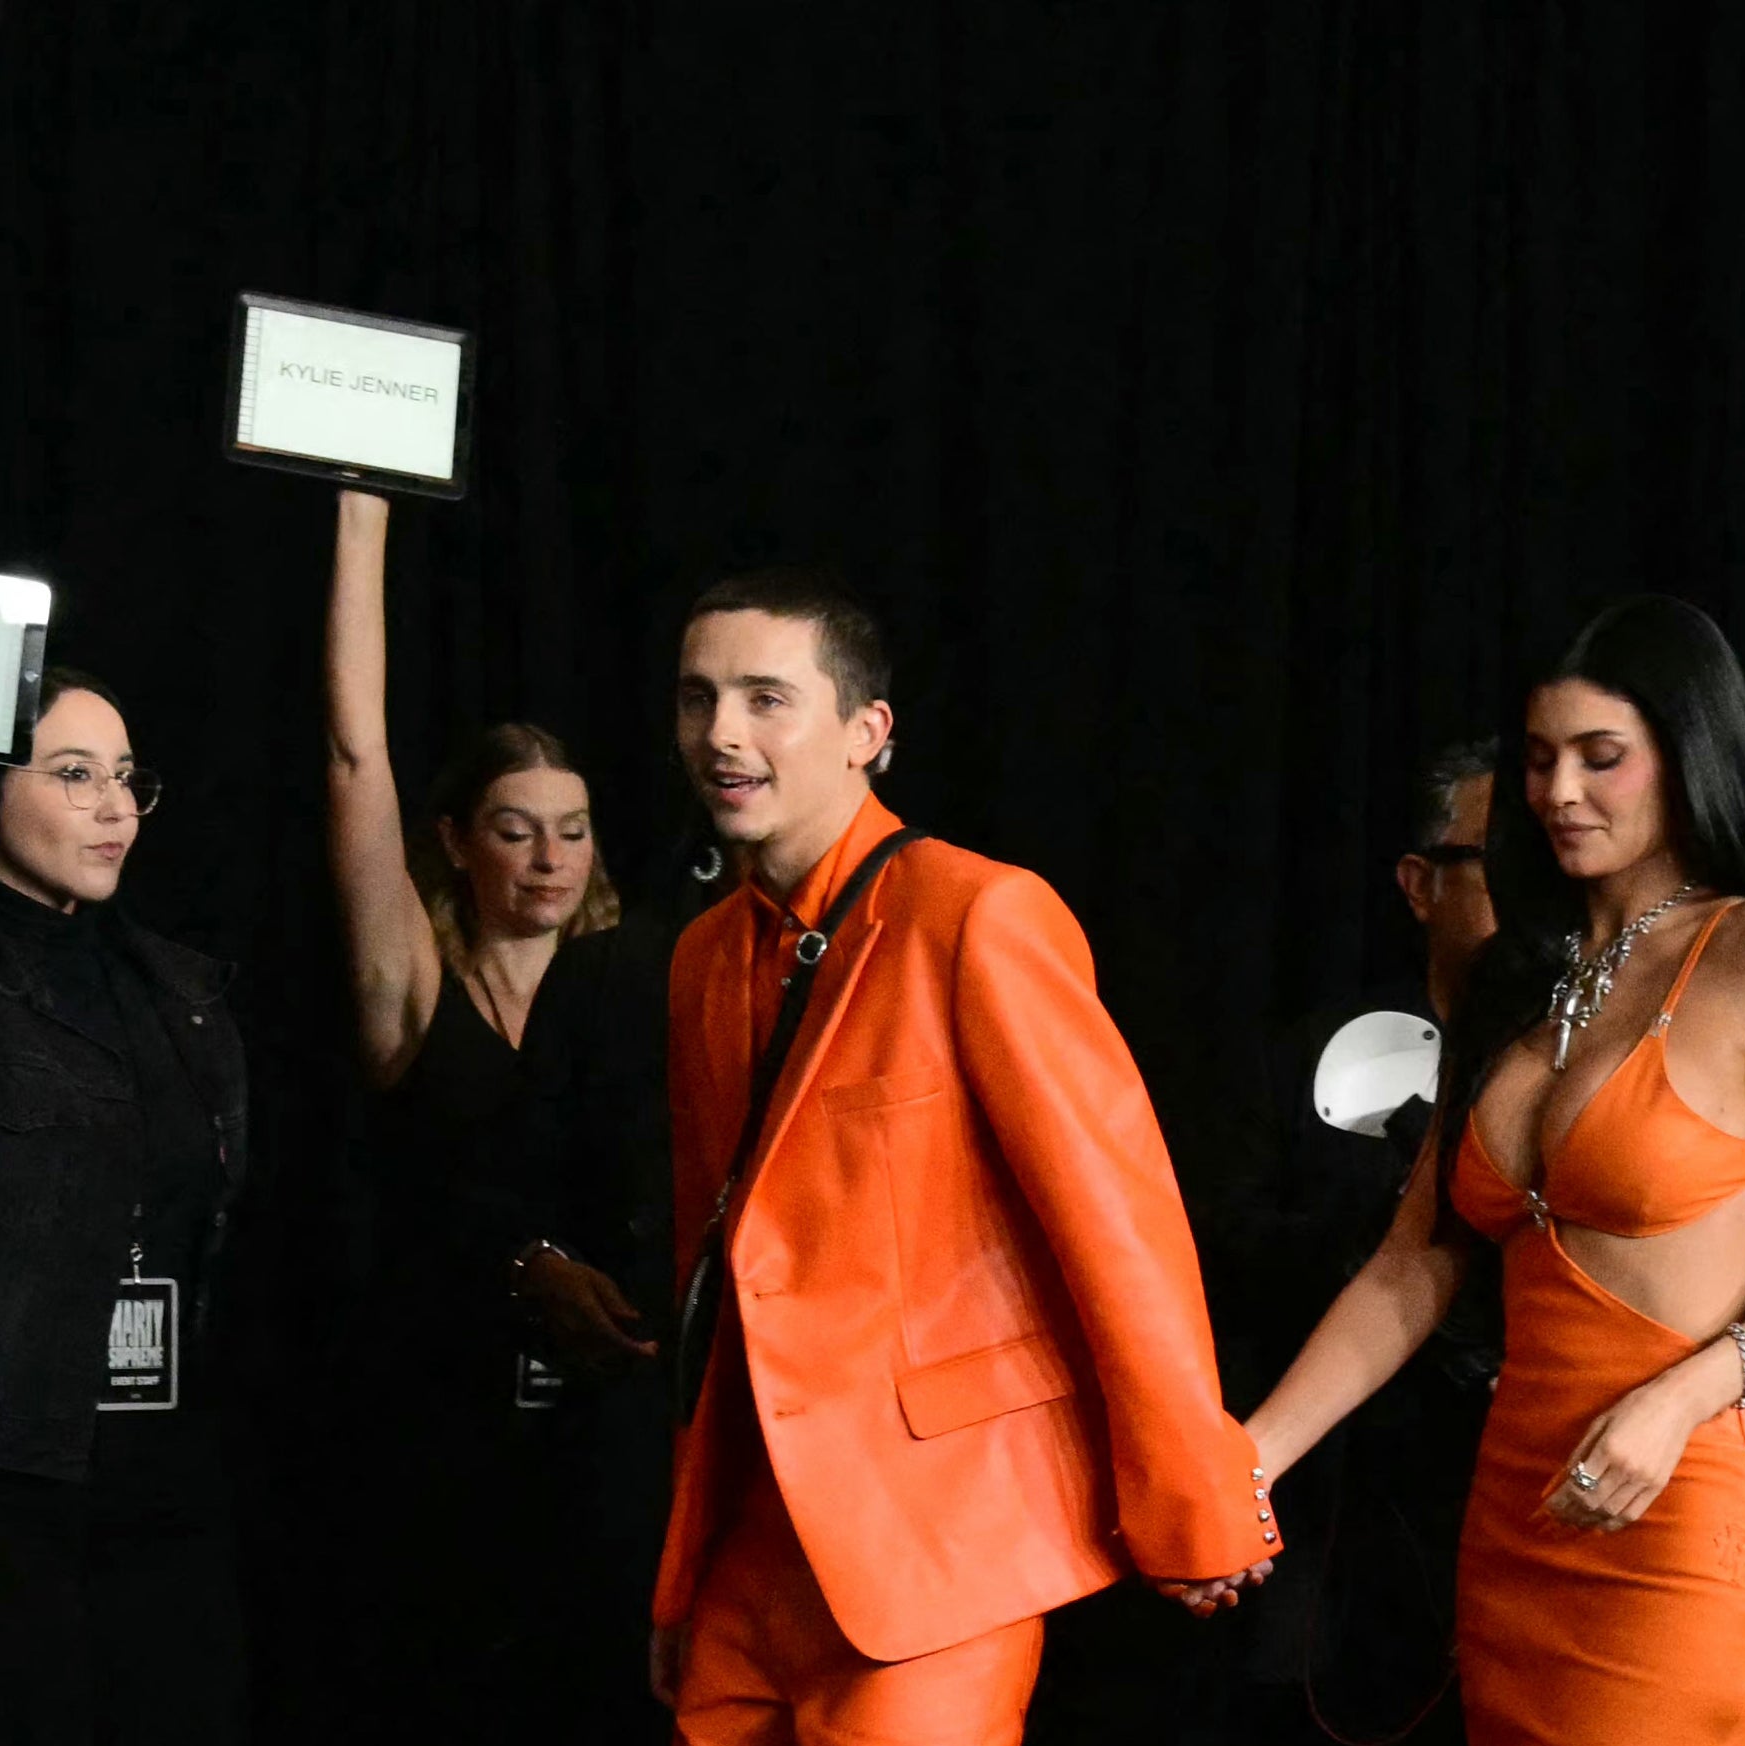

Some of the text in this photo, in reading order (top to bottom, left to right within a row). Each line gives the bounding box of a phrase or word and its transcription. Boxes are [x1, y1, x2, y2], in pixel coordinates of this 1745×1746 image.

[279, 360, 439, 405] KYLIE JENNER
[108, 1299, 164, 1347] MARTY
